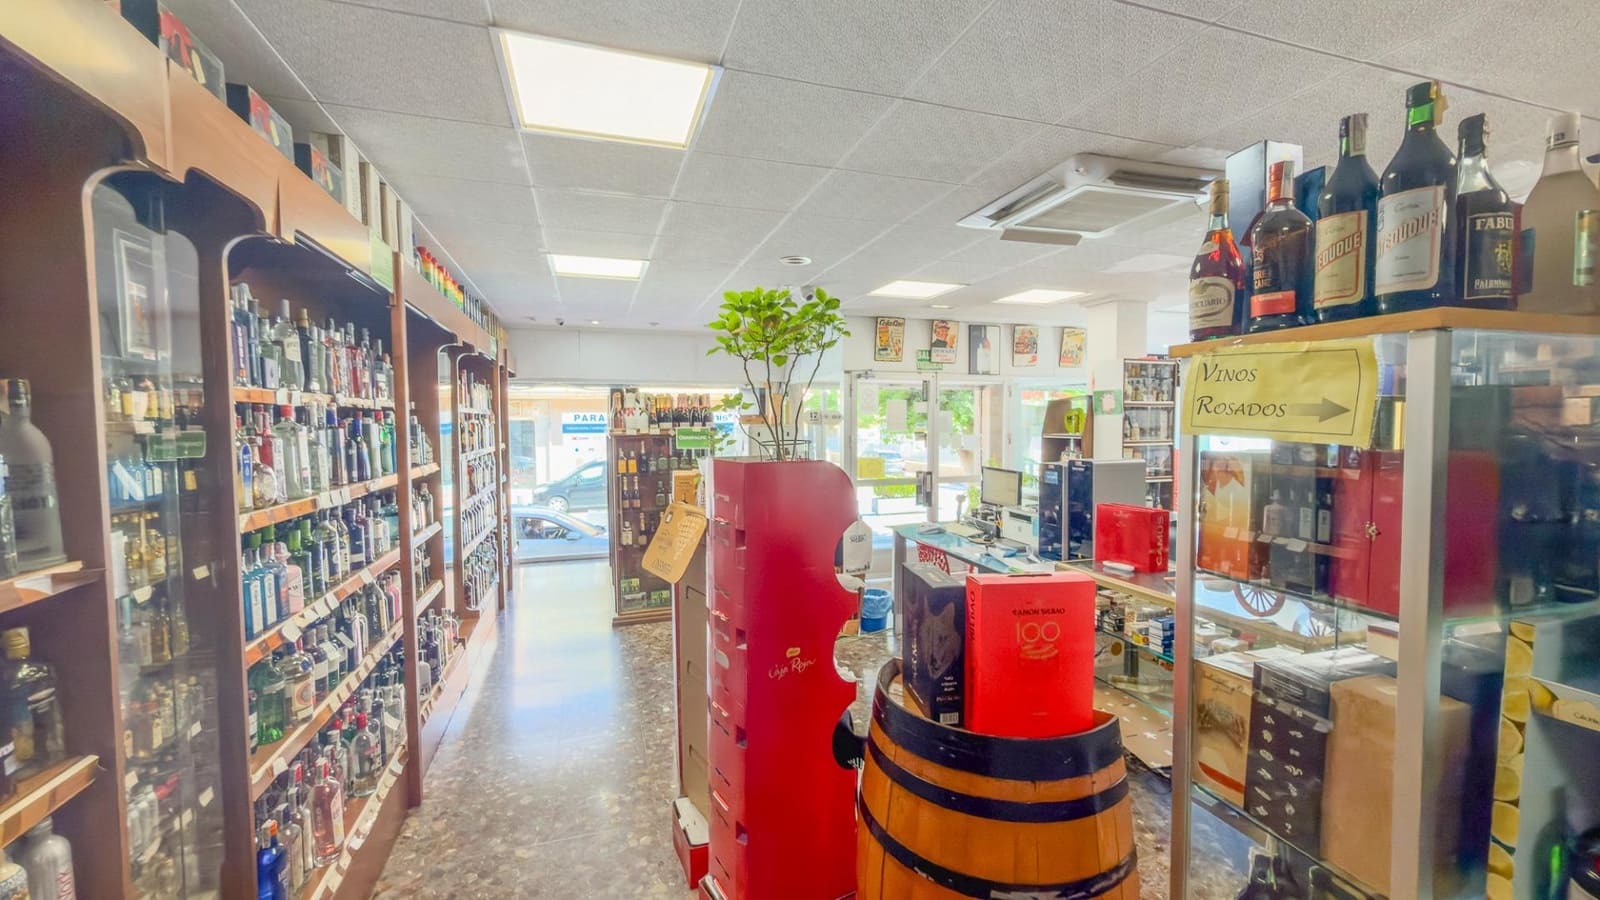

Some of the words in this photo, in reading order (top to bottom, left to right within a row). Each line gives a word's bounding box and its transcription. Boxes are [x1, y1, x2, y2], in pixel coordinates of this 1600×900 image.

[1196, 395, 1288, 418] ROSADOS
[1156, 514, 1164, 567] CAMUS
[1015, 621, 1061, 643] 100
